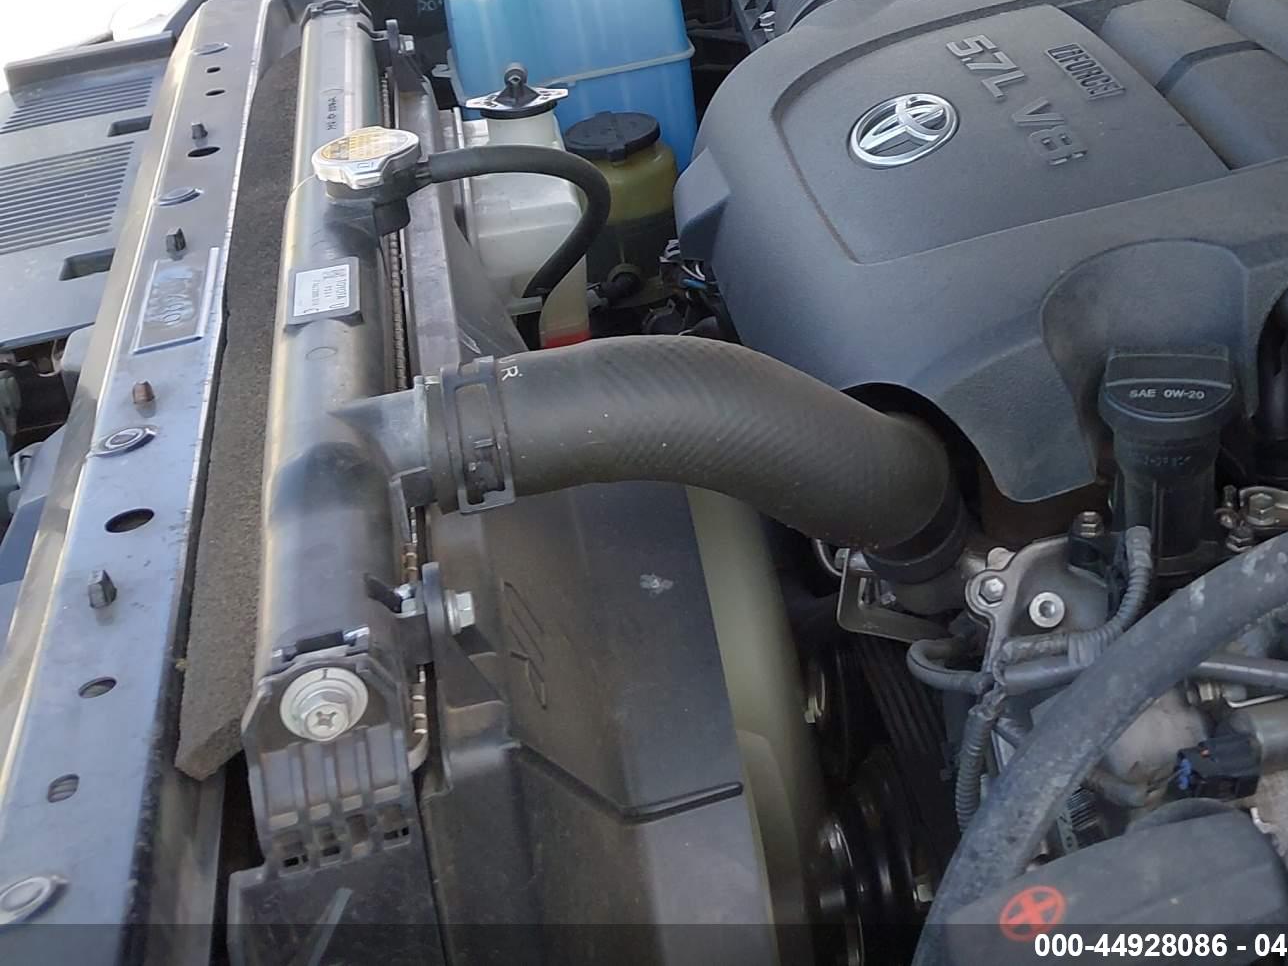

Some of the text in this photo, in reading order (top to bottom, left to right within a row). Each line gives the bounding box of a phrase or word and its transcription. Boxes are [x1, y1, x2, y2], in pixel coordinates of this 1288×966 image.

[946, 34, 1025, 99] 5.7L
[1129, 388, 1205, 400] SAE 0W-20
